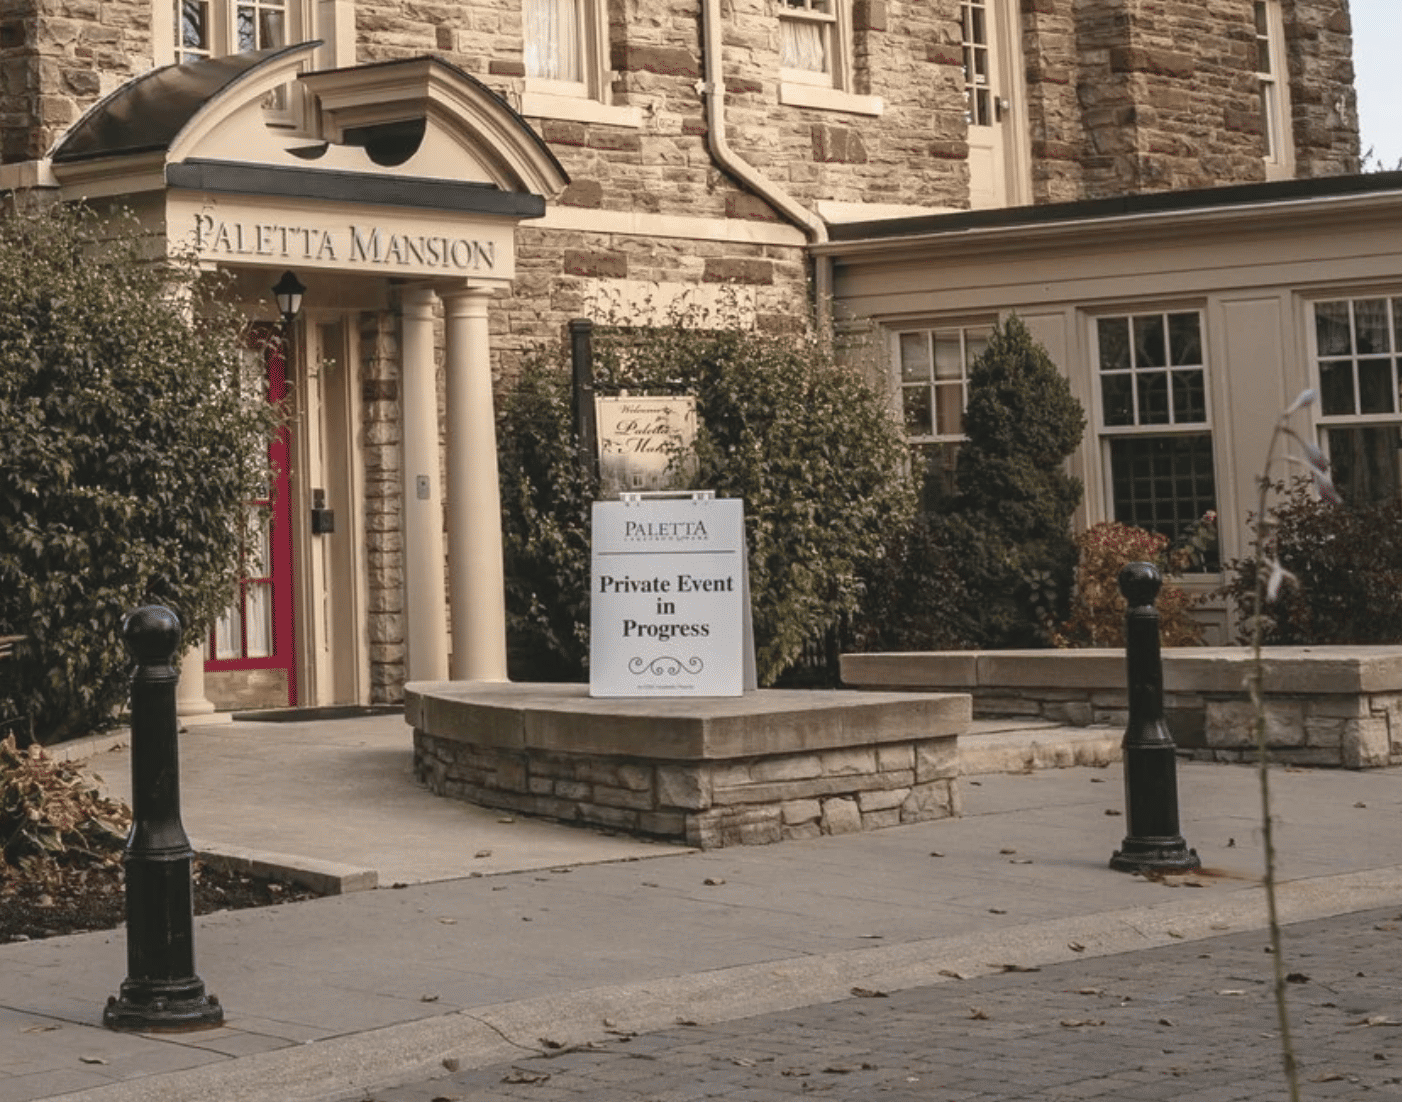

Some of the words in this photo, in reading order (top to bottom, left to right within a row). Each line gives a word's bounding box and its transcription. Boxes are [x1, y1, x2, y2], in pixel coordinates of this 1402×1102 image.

[194, 213, 337, 260] PALETTA
[349, 225, 496, 269] MANSION
[625, 520, 708, 537] PALETTA
[599, 575, 671, 594] Private
[677, 574, 734, 593] Event
[656, 597, 676, 615] in
[622, 619, 710, 642] Progress
